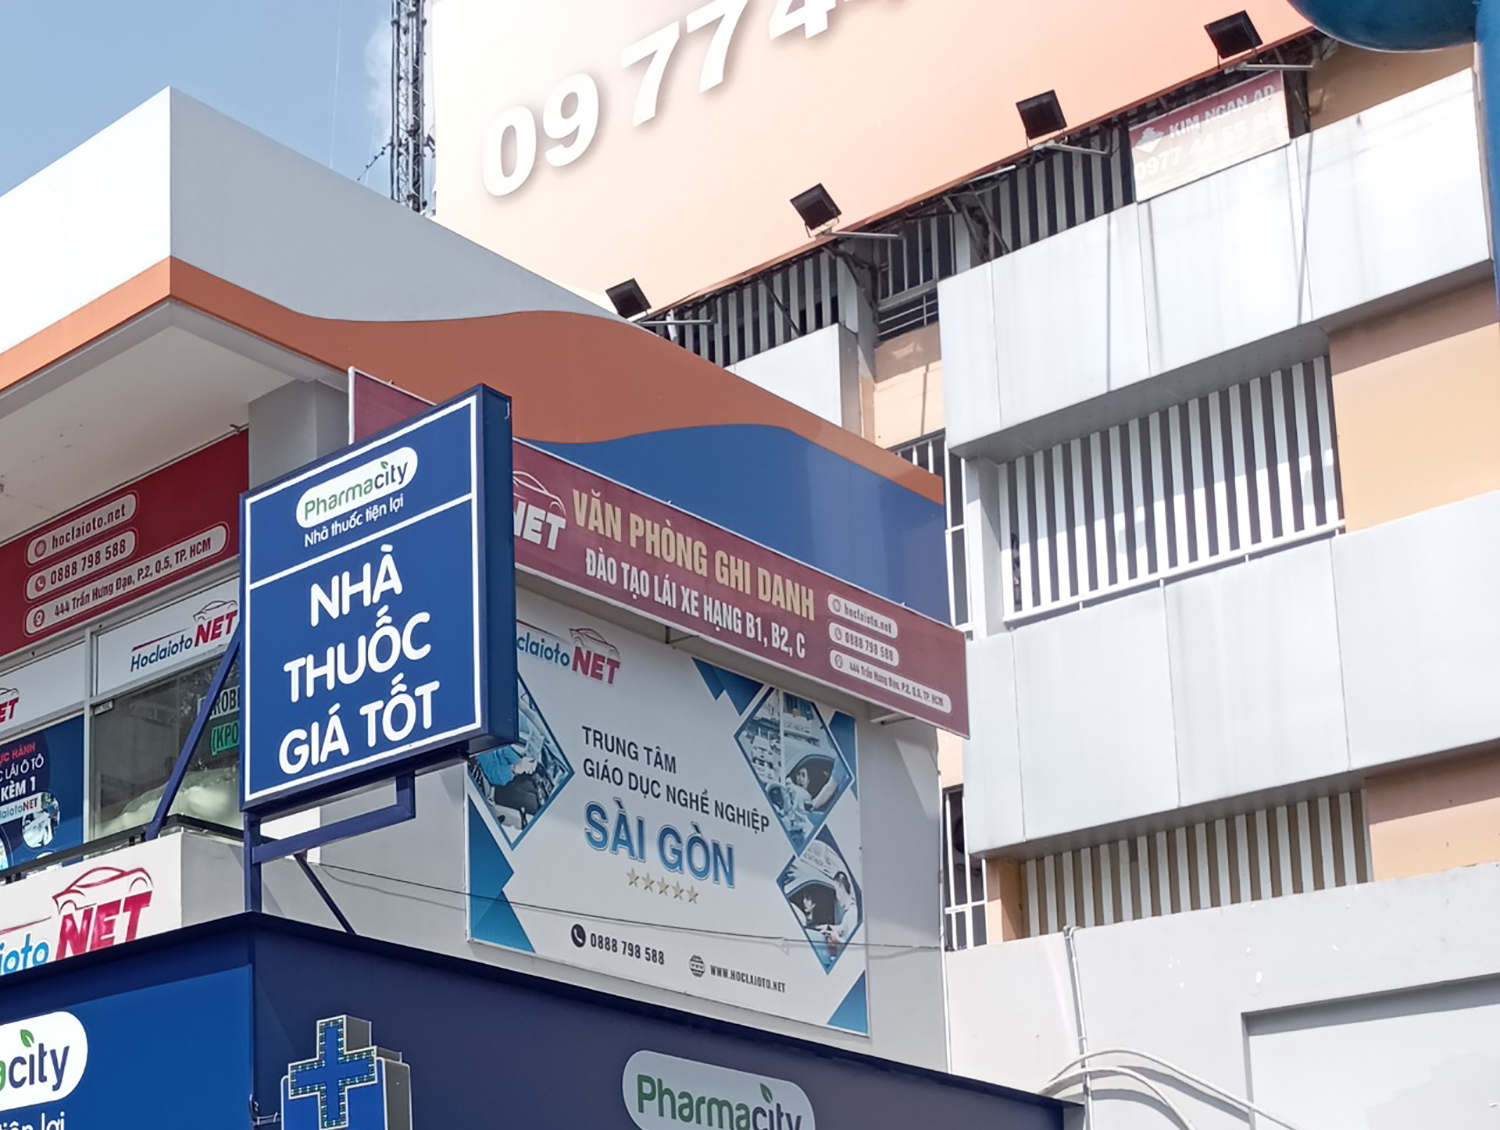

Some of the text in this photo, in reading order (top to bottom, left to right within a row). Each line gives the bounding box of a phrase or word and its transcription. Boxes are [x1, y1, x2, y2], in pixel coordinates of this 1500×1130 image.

[482, 73, 599, 196] 09
[51, 504, 126, 549] hoclaioto.net
[304, 460, 409, 521] Pharmacity
[304, 497, 404, 547] Nhà thuốc tiện lợi
[50, 539, 127, 586] 0888 798 588
[310, 543, 403, 626] NHÀ
[572, 489, 815, 621] VĂN PHÒNG GHI DANH
[586, 547, 617, 585] ĐÀO
[621, 562, 650, 599] TẠO
[654, 573, 677, 609] LÁI
[680, 590, 700, 618] XE
[703, 596, 742, 634] HẠNG
[796, 633, 805, 660] C
[284, 605, 431, 703] THUỐC
[279, 704, 350, 775] GIÁ
[359, 674, 440, 748] TỐT
[582, 726, 677, 774] TRUNG TÂM
[582, 758, 770, 835] GIÁO DỤC NGHỀ NGHIỆP
[584, 798, 735, 888] SÀI GÒN
[590, 934, 665, 965] 0888 798 588
